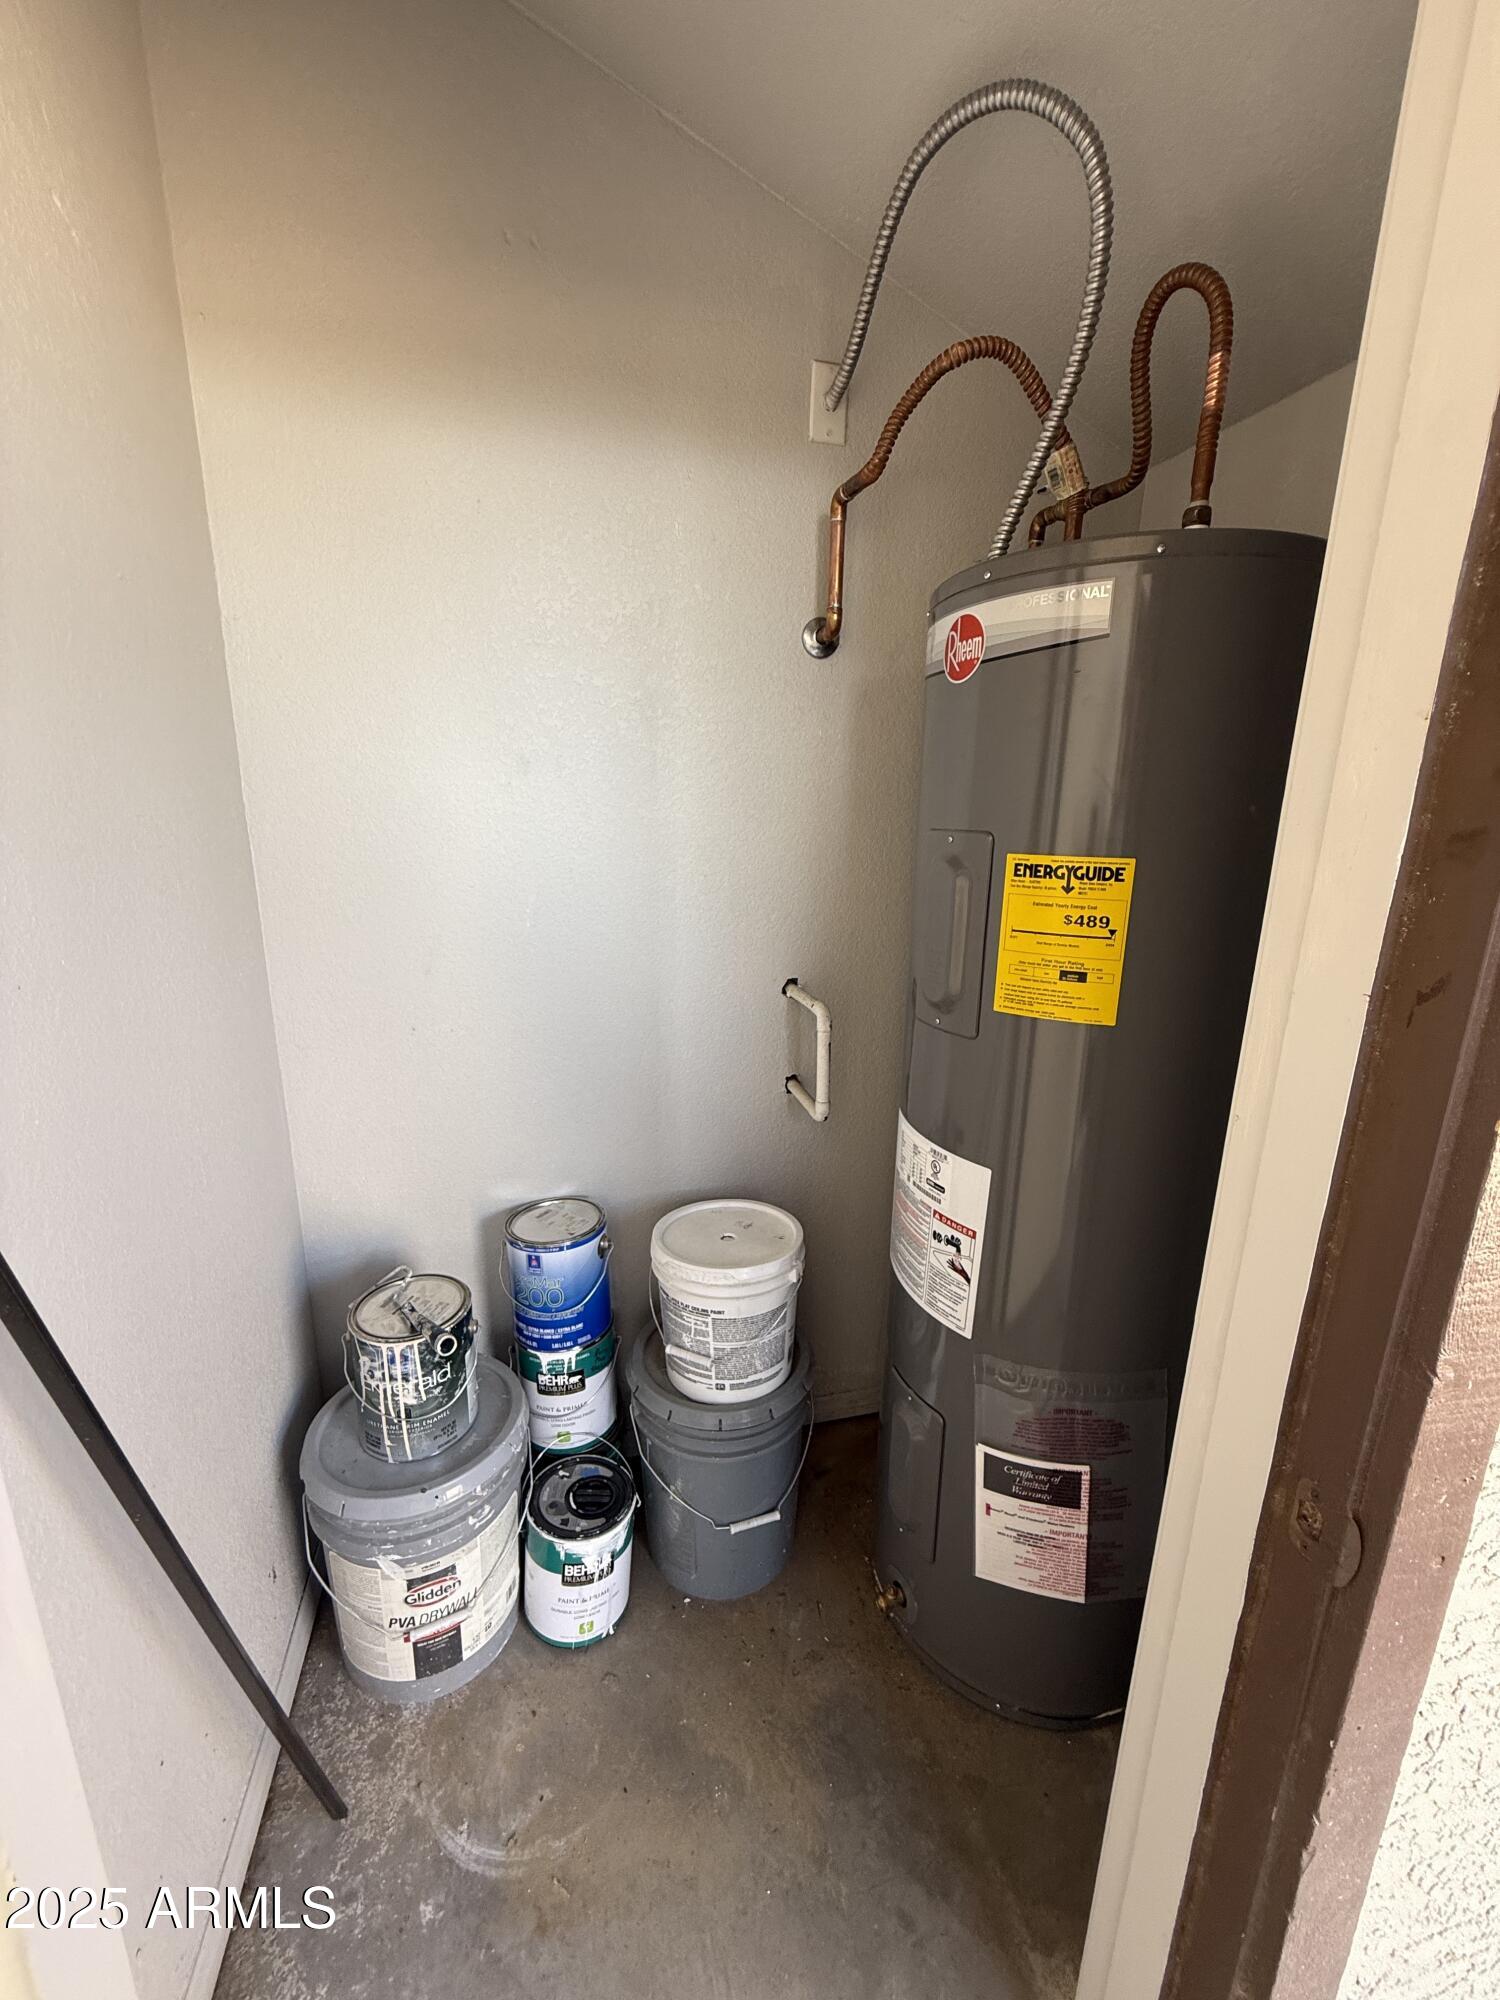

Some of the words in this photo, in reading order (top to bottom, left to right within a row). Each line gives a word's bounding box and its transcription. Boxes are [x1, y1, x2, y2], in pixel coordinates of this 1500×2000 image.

[947, 617, 983, 673] Rheem
[1013, 863, 1127, 883] ENERGYGUIDE
[1063, 914, 1111, 929] $489
[941, 1216, 974, 1237] DANGER
[516, 1287, 565, 1308] 200
[537, 1373, 569, 1386] BEHR
[567, 1382, 583, 1391] PLUS
[367, 1419, 399, 1430] URETANE
[406, 1422, 420, 1430] RIM
[422, 1409, 450, 1426] ENAMEL
[1004, 1465, 1049, 1481] Certificate
[1015, 1478, 1050, 1491] Limited
[564, 1564, 591, 1576] BEH
[404, 1579, 462, 1606] Glidden
[558, 1597, 579, 1605] PAINT
[388, 1616, 416, 1628] PVA
